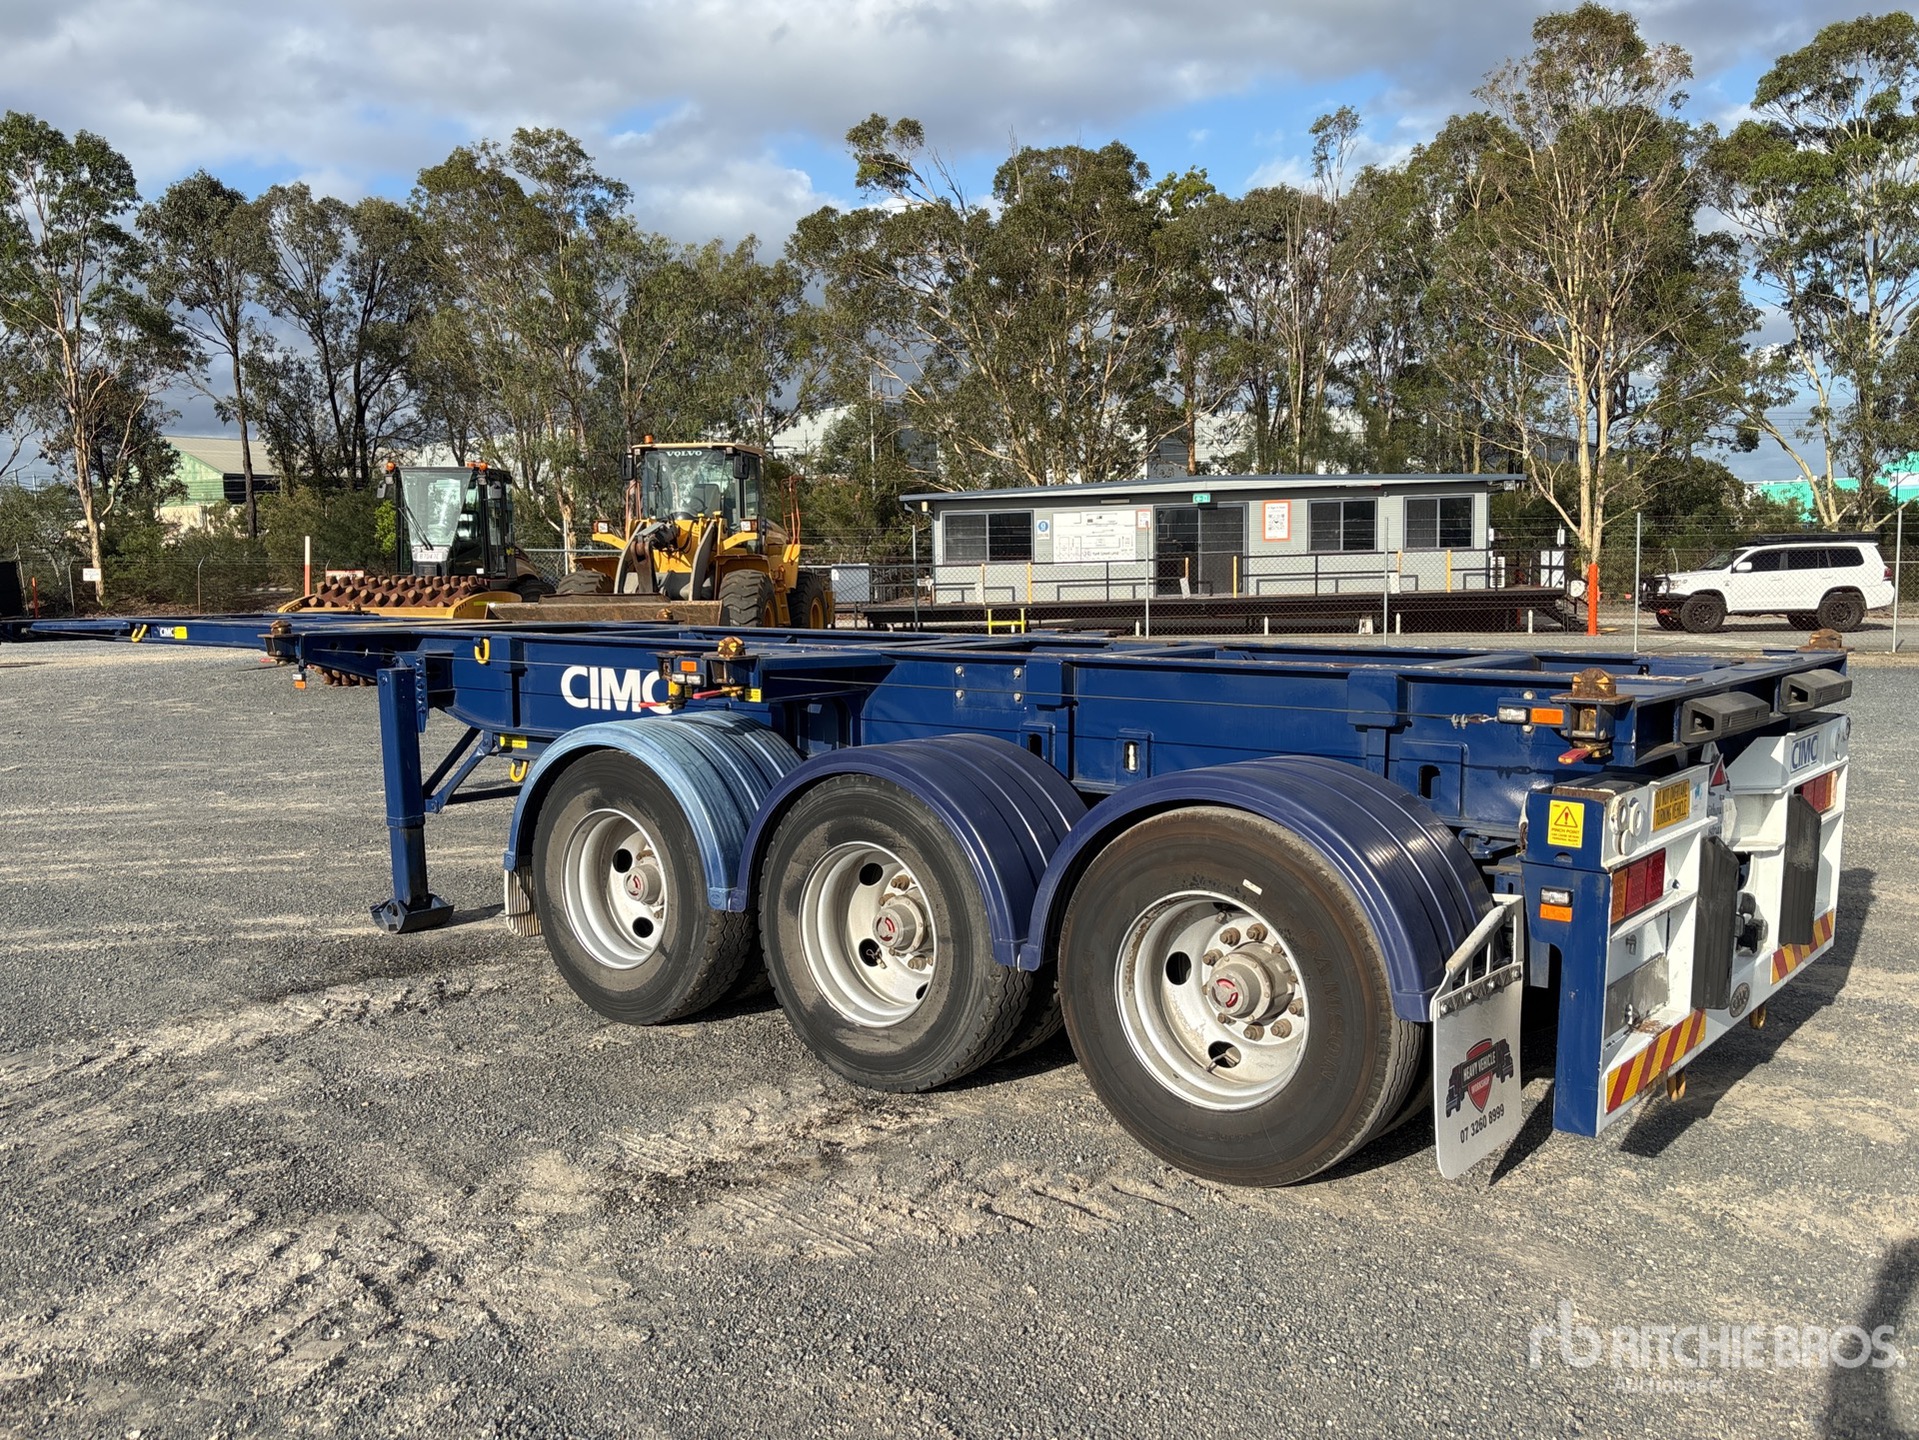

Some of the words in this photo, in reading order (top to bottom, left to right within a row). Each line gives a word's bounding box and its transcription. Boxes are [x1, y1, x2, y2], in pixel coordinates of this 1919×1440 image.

[560, 665, 673, 715] CIMC
[1791, 735, 1818, 769] CIMC
[1655, 790, 1662, 809] DO
[1662, 787, 1670, 806] NOT
[1463, 1061, 1478, 1082] HEAVY
[1478, 1050, 1496, 1073] VEHICLE
[1460, 1127, 1469, 1144] 07
[1470, 1115, 1487, 1137] 3260
[1488, 1103, 1505, 1124] 8999
